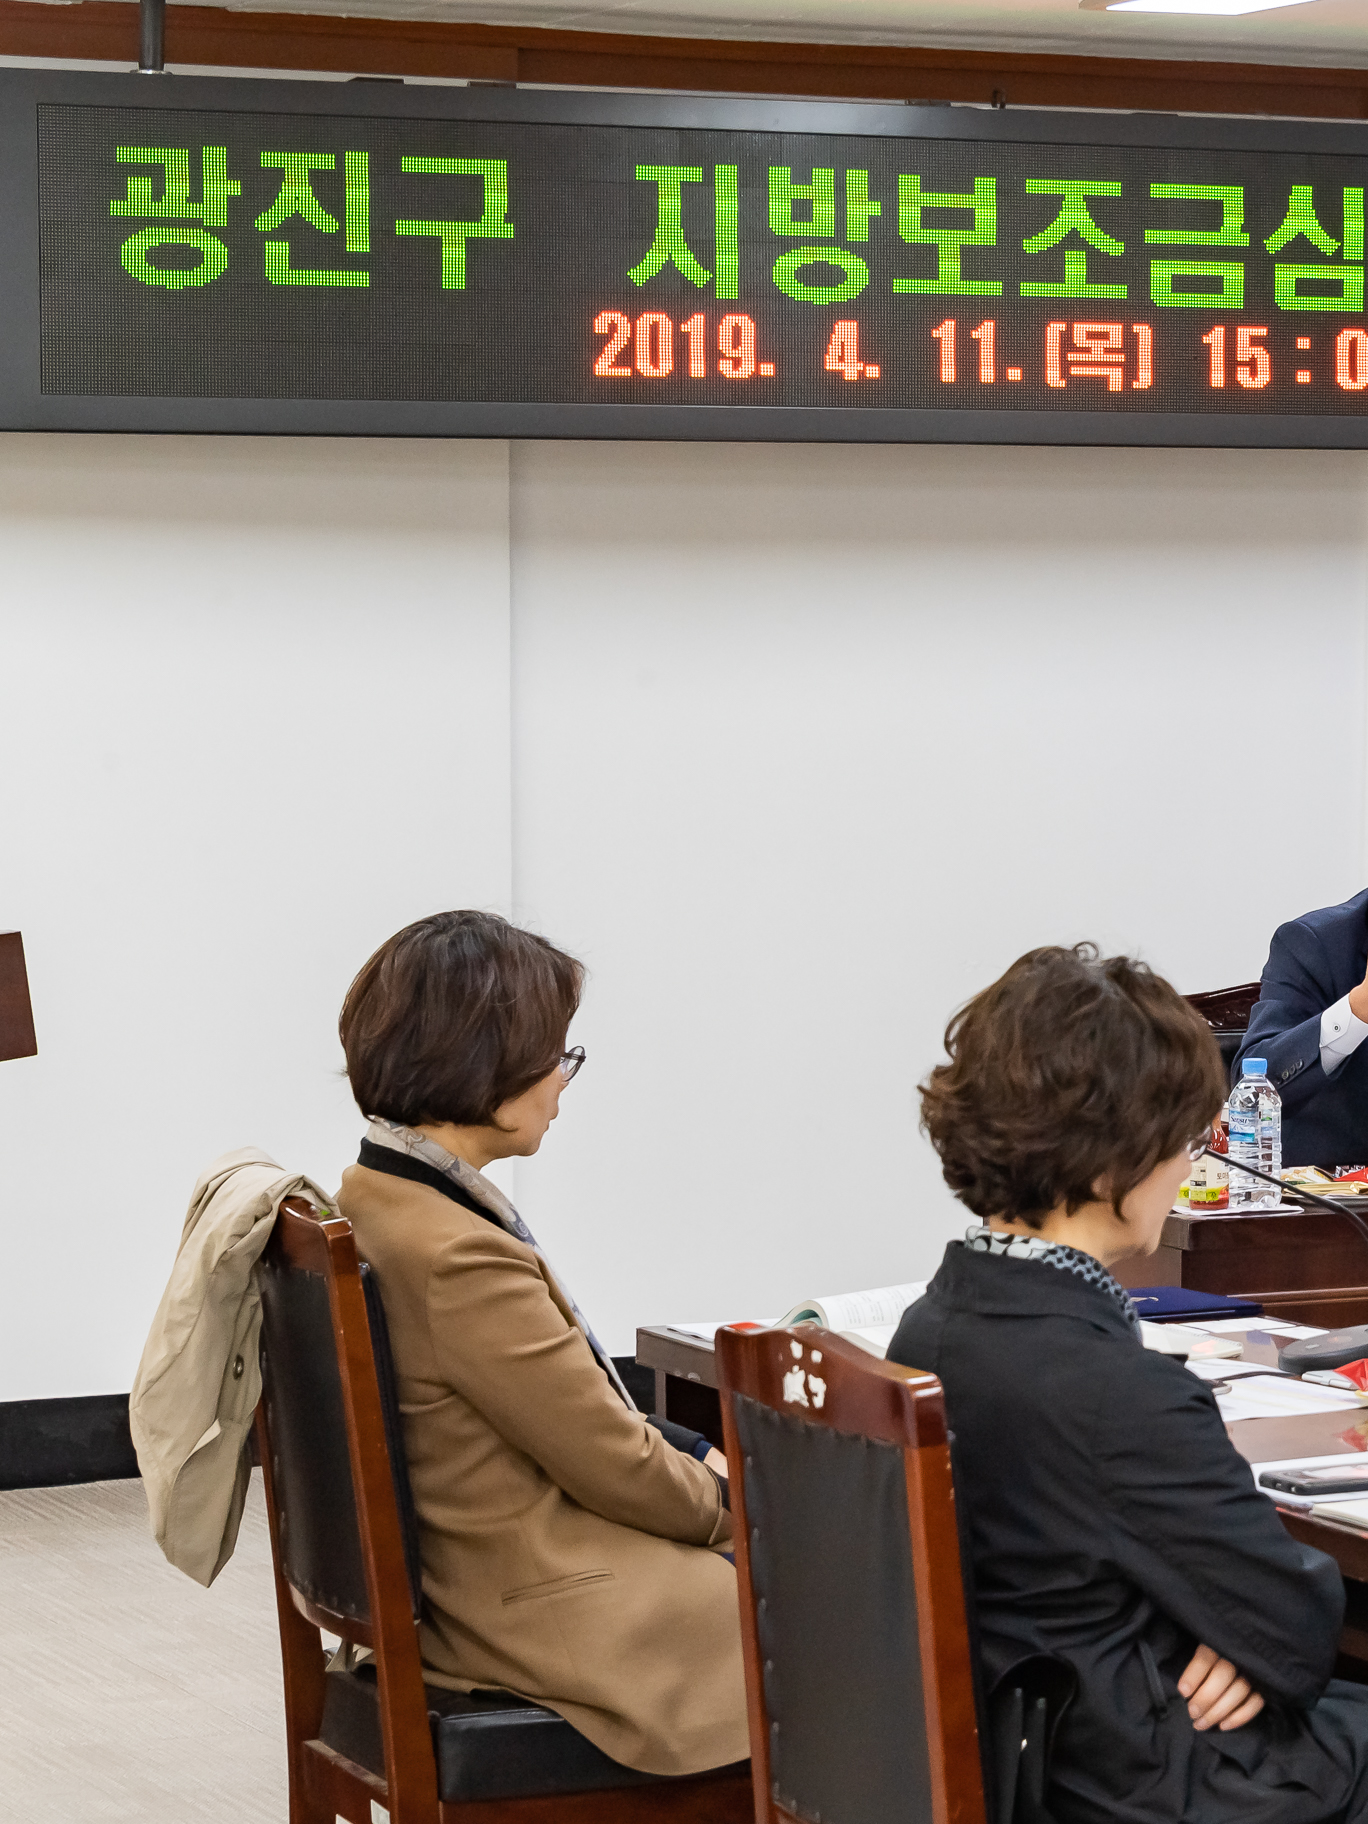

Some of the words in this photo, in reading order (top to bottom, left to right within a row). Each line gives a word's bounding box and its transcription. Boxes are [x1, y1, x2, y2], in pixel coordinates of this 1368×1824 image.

[109, 145, 515, 290] 광진구
[592, 309, 777, 381] 2019.
[823, 319, 882, 382] 4.
